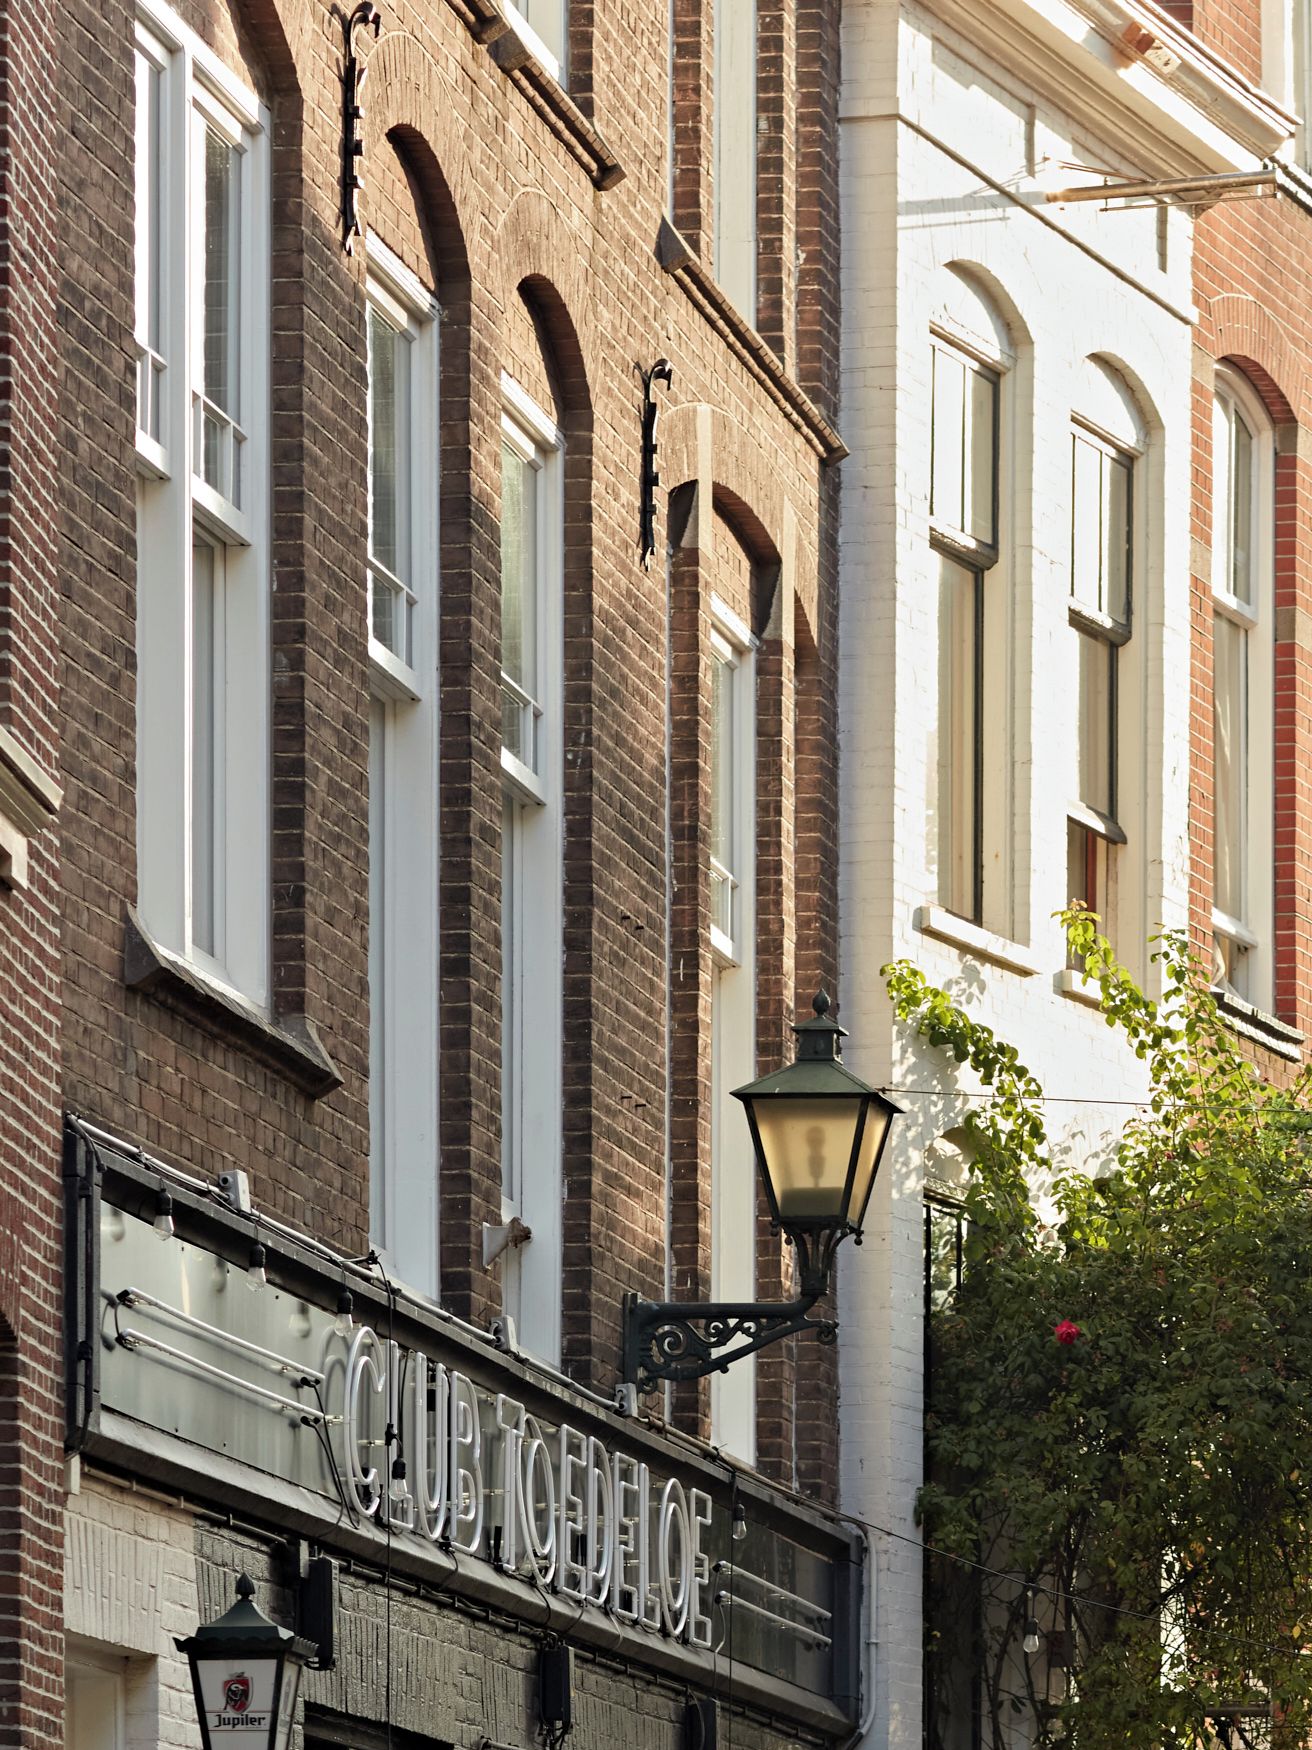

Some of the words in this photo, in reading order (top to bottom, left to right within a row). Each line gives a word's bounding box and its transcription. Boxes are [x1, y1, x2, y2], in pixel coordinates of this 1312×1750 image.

[344, 1326, 484, 1552] CLUB
[495, 1392, 713, 1648] TOEDELOE
[213, 1714, 266, 1729] Jupiler
